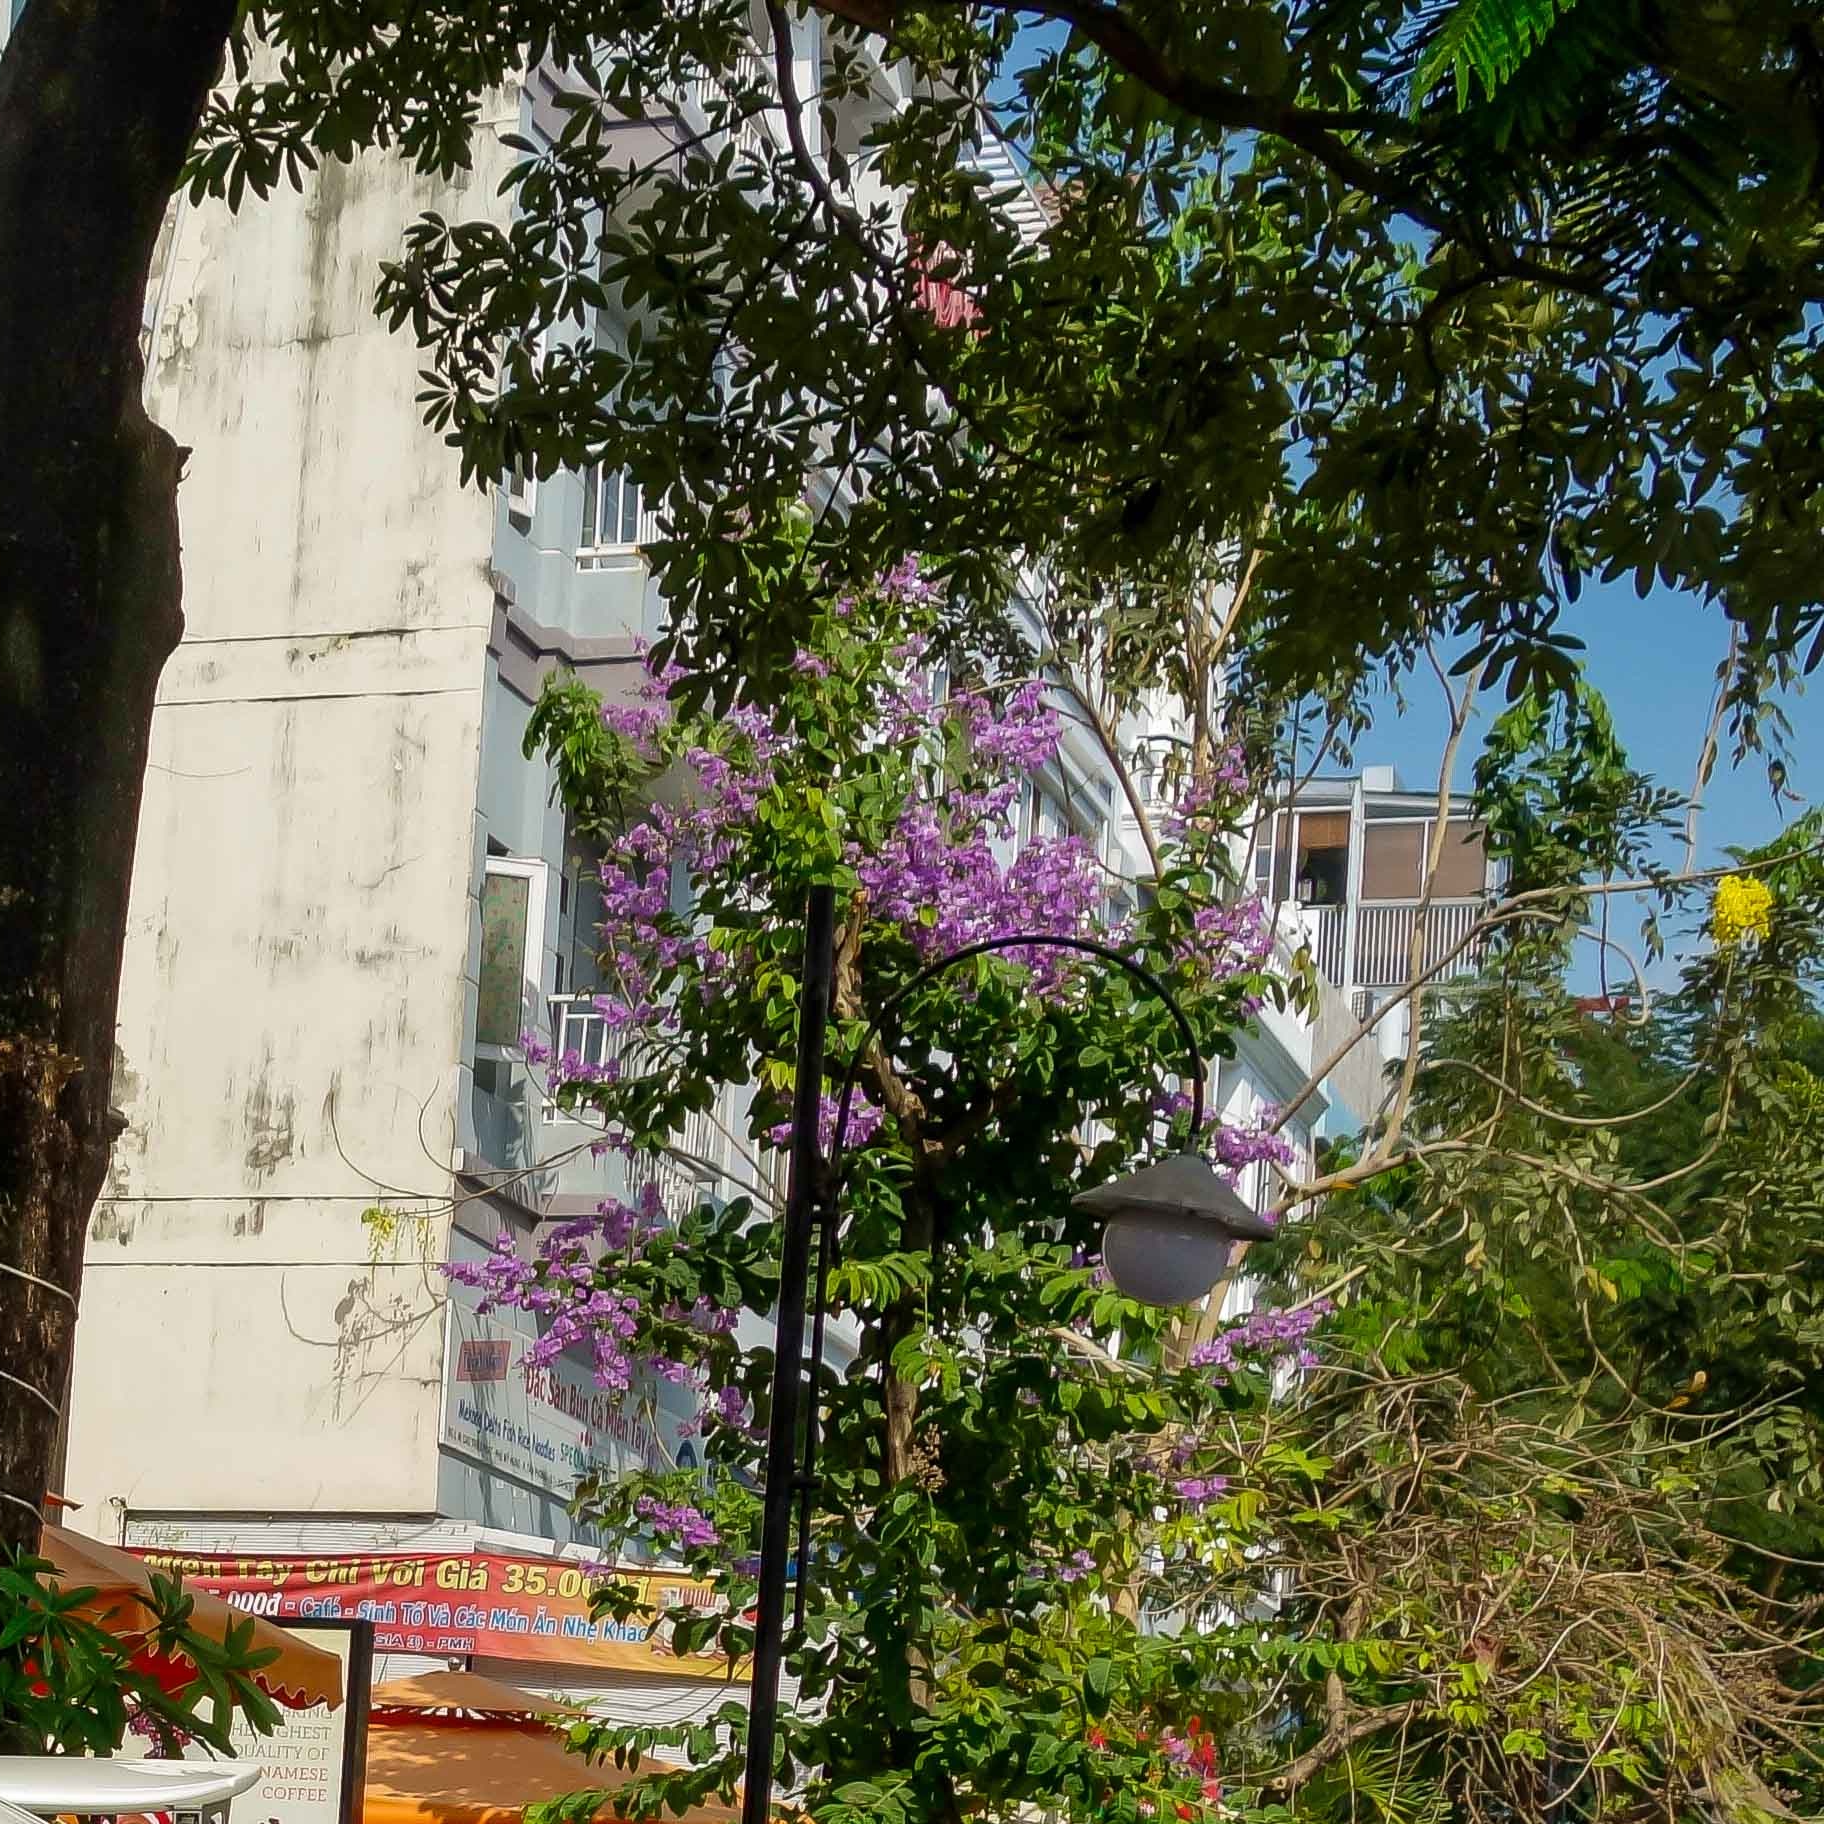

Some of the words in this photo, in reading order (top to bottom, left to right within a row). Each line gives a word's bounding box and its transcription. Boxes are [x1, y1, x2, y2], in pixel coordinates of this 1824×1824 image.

[436, 1559, 489, 1591] Giá
[356, 1599, 397, 1623] Sinh
[454, 1604, 487, 1631] Các
[488, 1607, 530, 1634] Món
[531, 1605, 558, 1637] Ăn
[560, 1614, 597, 1645] Nhẹ
[262, 1786, 328, 1802] COFFEE
